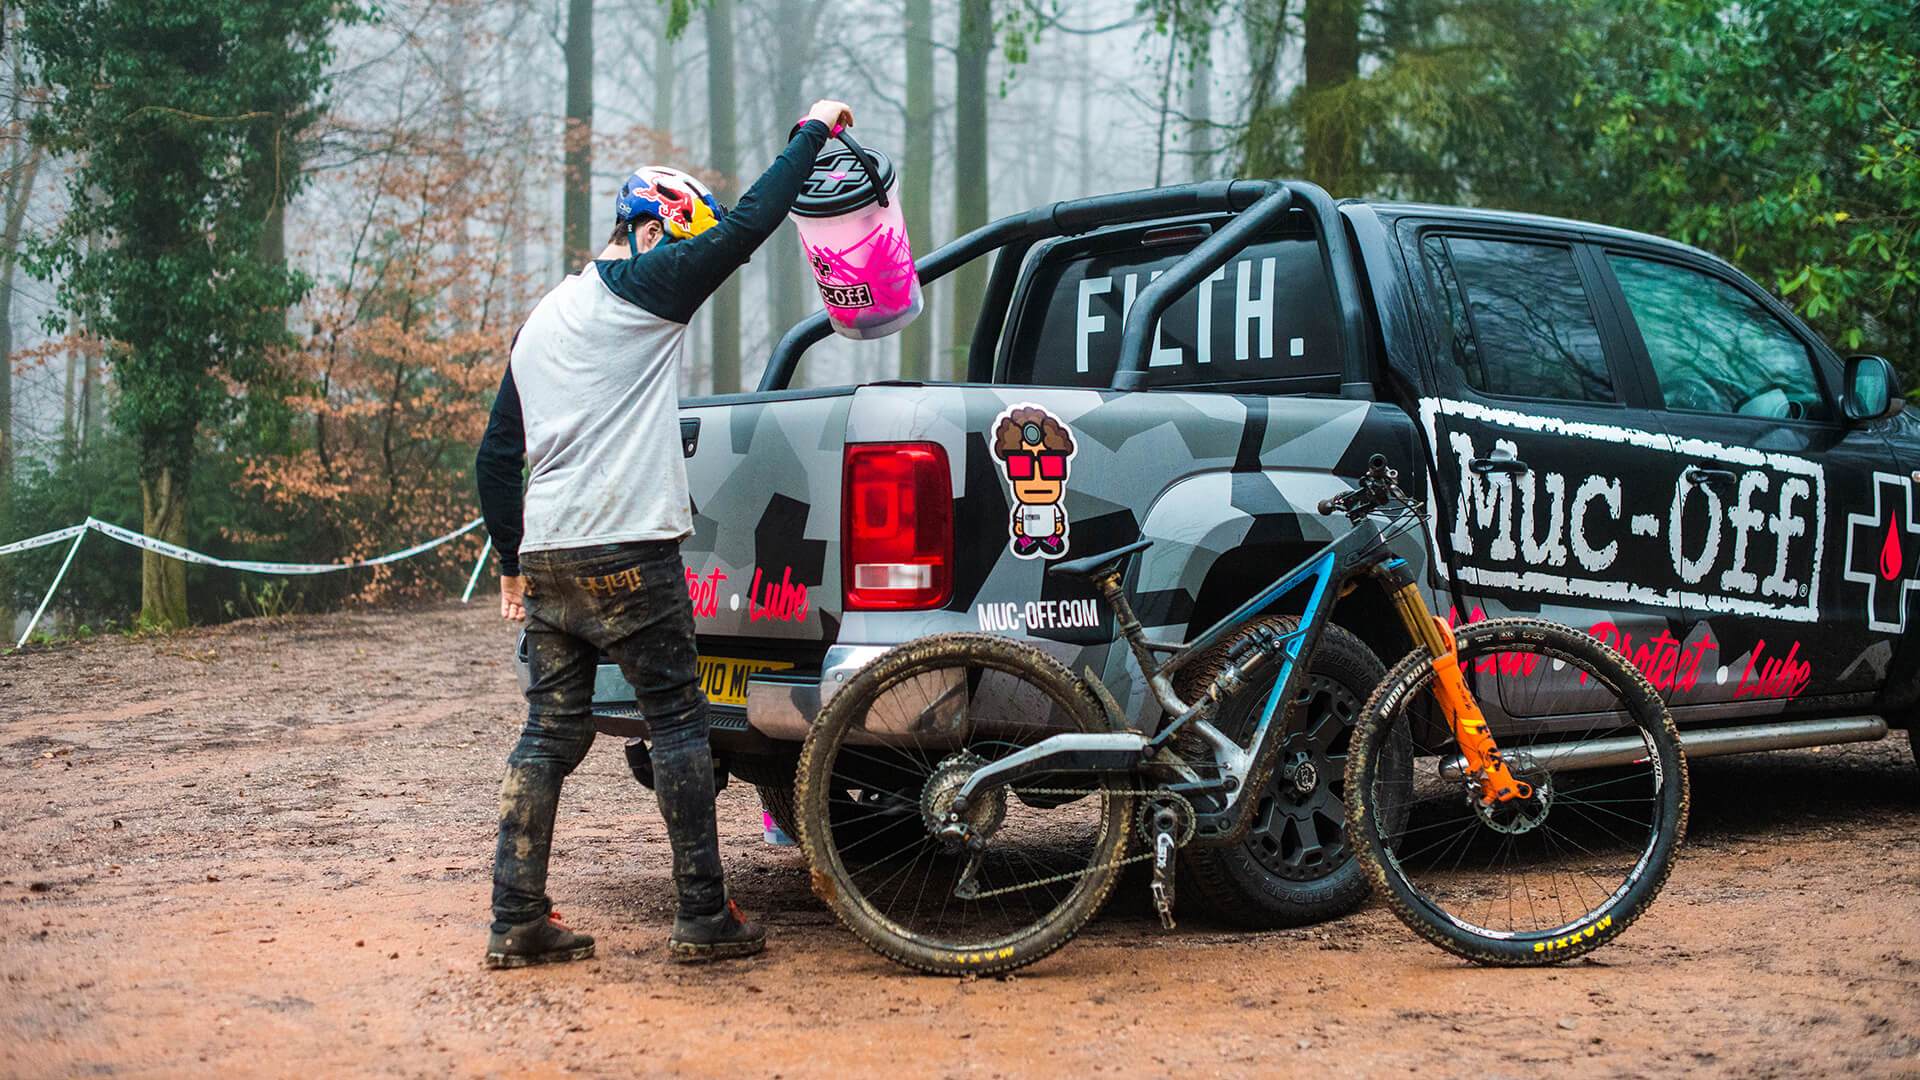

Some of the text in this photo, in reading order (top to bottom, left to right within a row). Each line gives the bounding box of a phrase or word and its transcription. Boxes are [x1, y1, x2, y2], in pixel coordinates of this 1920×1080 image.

[821, 287, 867, 305] c-Off
[1450, 431, 1810, 599] Muc-Off
[750, 566, 809, 623] Lube
[977, 599, 1100, 632] MUC-OFF.COM
[1733, 639, 1811, 700] Lube
[1534, 917, 1612, 953] MAXXIS
